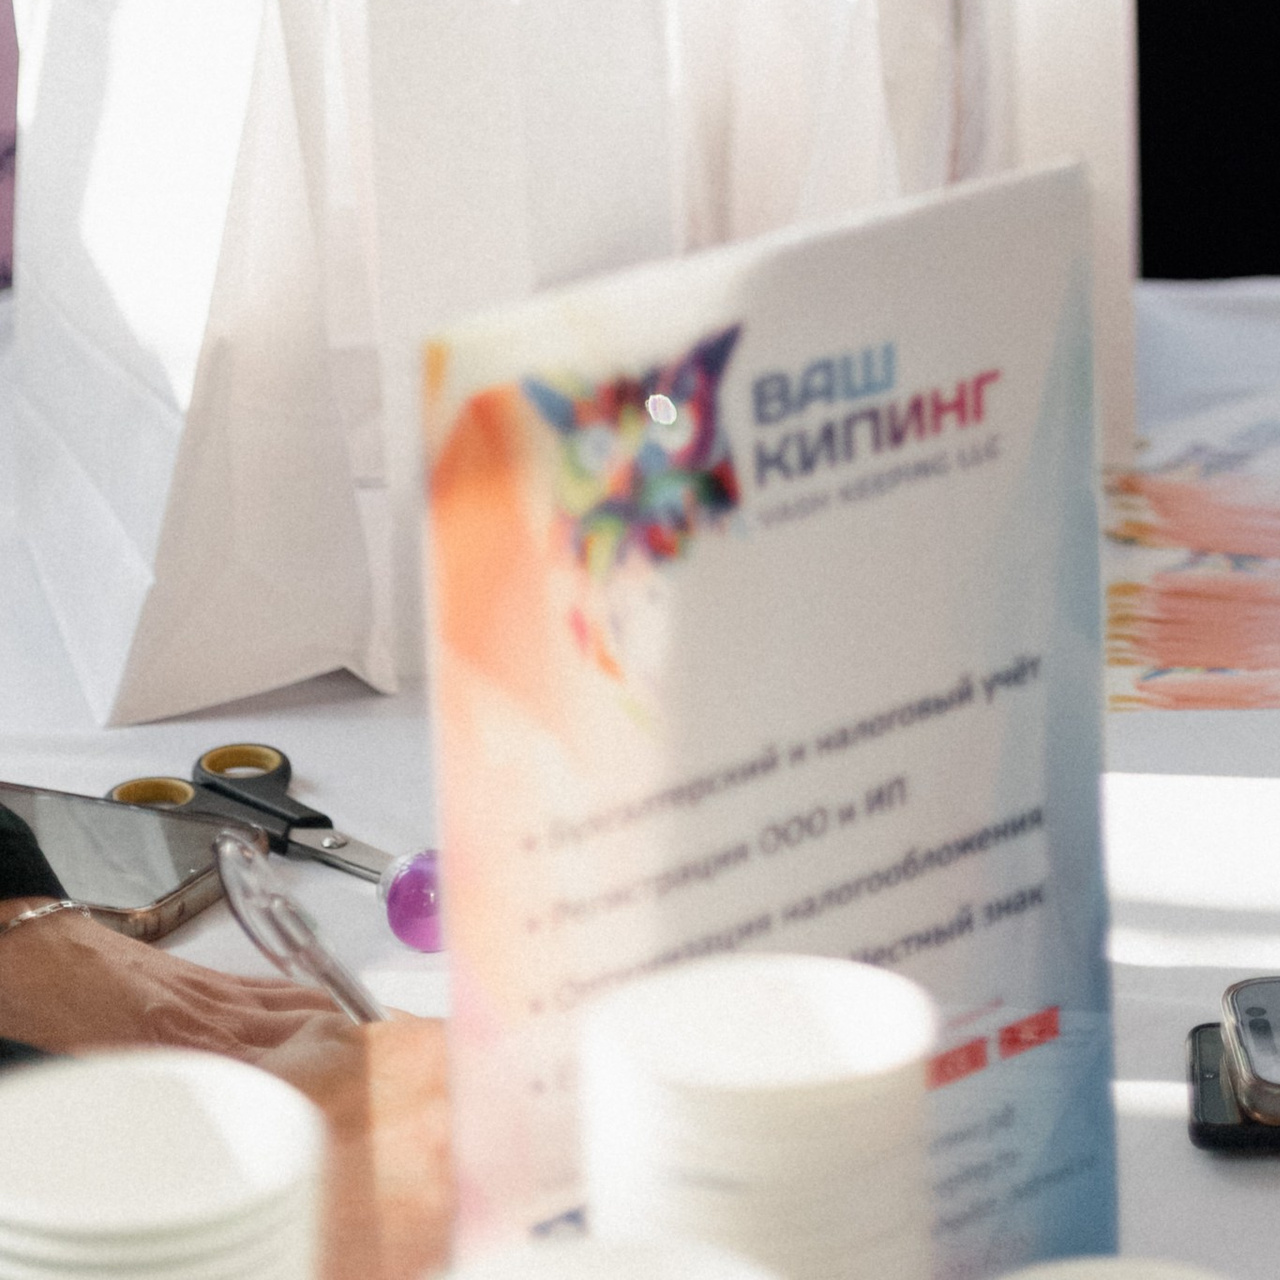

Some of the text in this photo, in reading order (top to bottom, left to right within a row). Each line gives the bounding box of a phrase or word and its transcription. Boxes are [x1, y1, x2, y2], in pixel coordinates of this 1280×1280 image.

[752, 340, 898, 427] ВАШ
[754, 366, 1004, 493] КИПИНГ
[789, 743, 806, 763] и
[816, 672, 974, 753] налоговый
[981, 654, 1042, 705] учёт
[757, 806, 828, 856] ООО
[838, 802, 855, 826] и
[864, 773, 907, 814] ИП
[780, 806, 1044, 925] налогообложения
[984, 884, 1044, 927] знак
